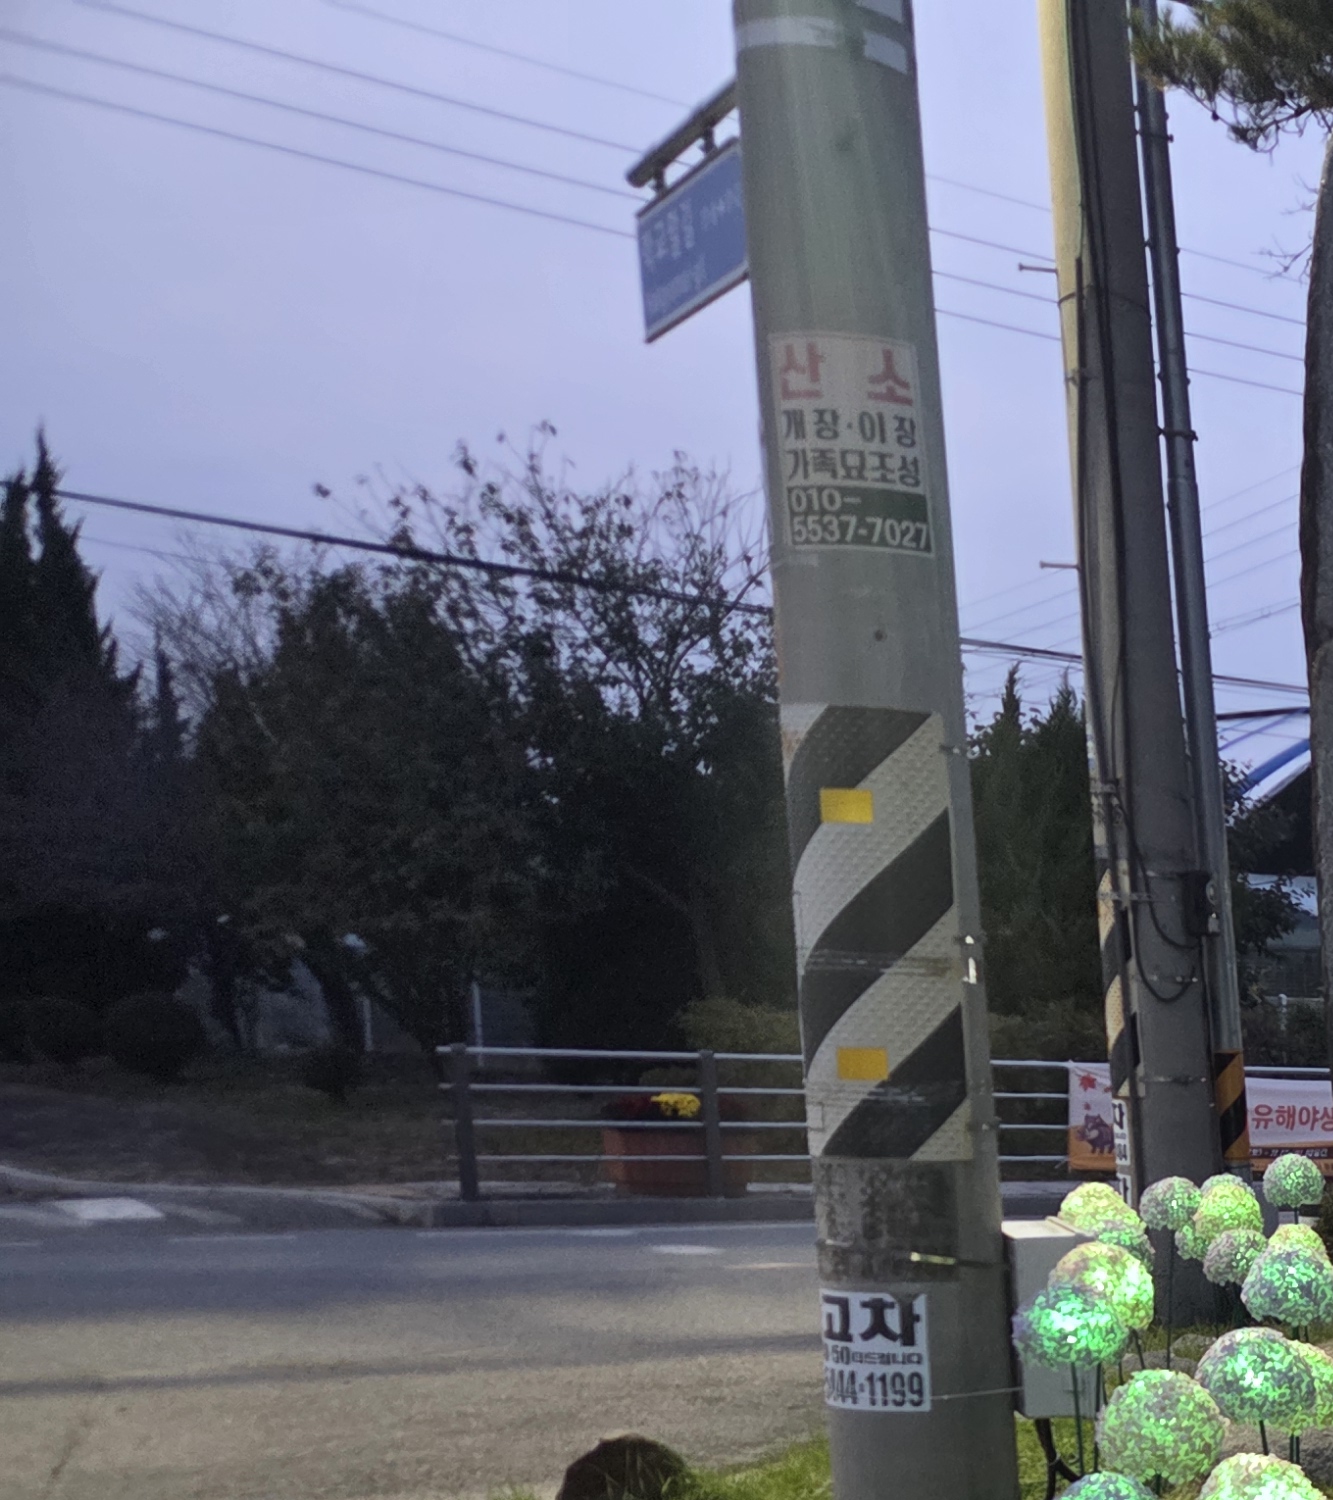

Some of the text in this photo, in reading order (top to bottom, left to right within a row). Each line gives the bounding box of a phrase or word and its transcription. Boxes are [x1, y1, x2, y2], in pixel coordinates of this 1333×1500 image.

[785, 449, 921, 488] 가족묘조성
[790, 487, 862, 512] 010-
[792, 514, 929, 549] 5537-7027
